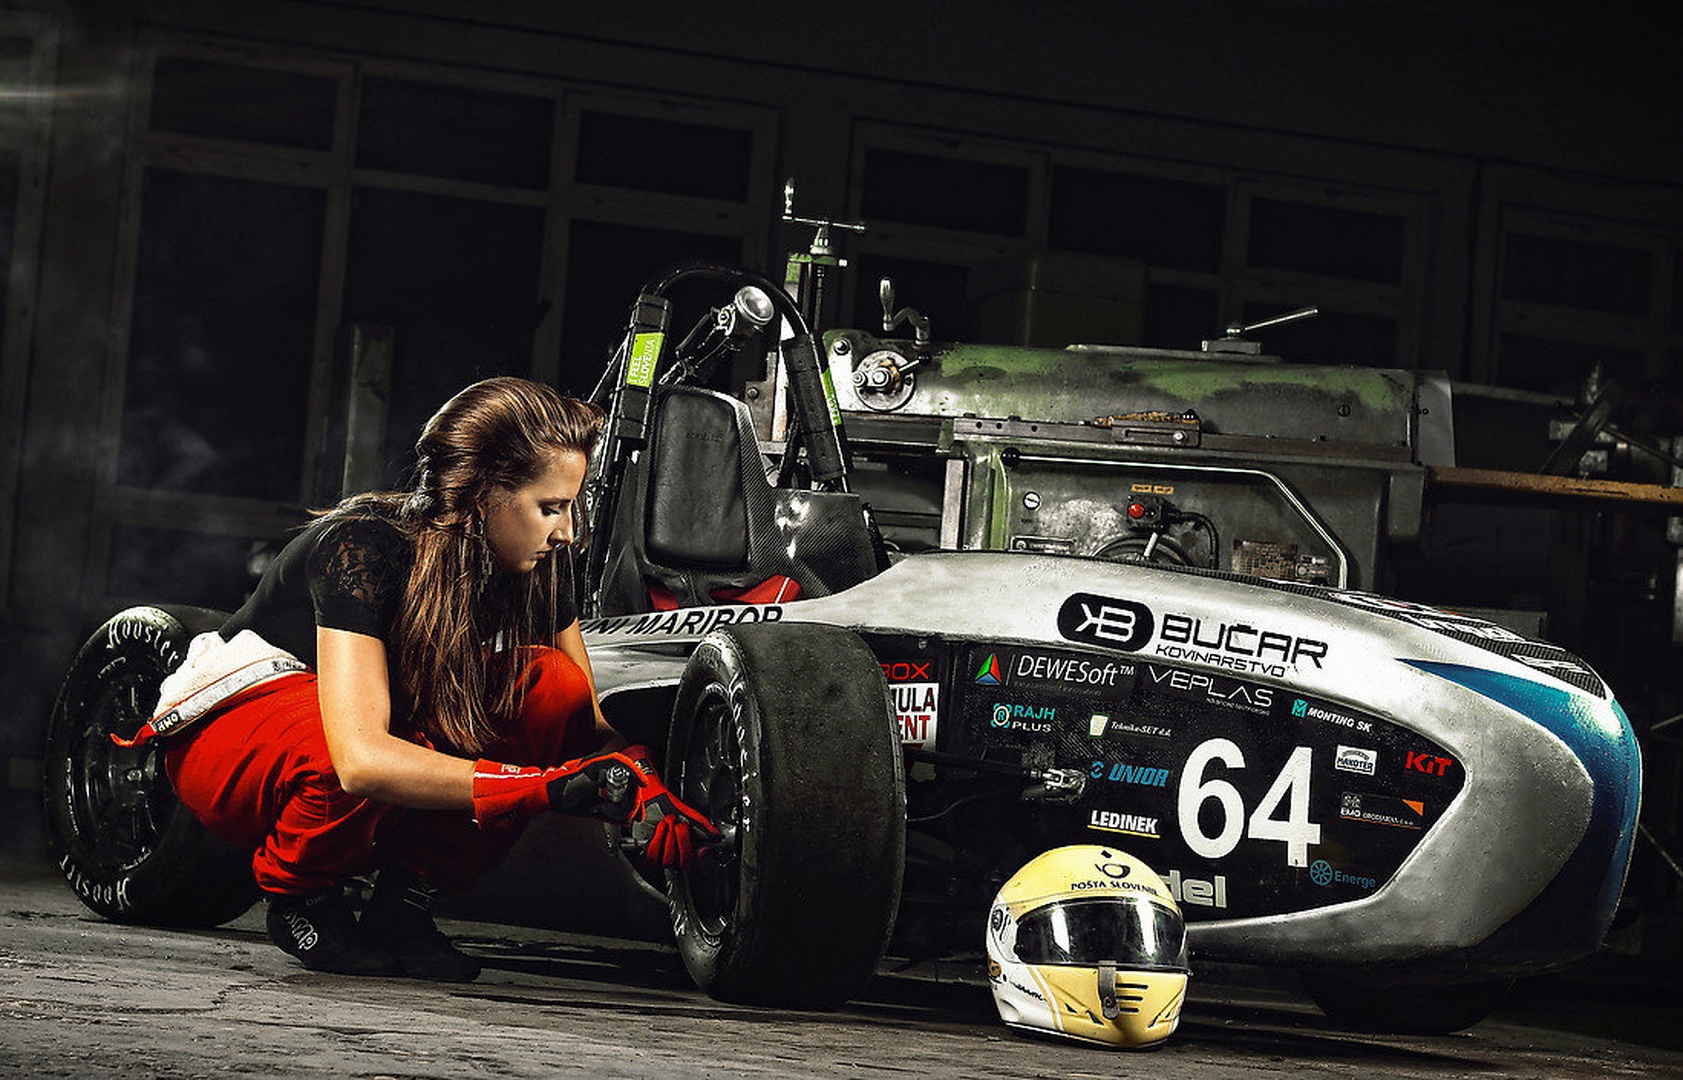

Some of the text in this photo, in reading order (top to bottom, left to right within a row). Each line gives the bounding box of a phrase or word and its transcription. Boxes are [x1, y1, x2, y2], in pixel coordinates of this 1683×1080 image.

[630, 355, 642, 377] FEEL
[640, 339, 655, 385] SLOVENIA
[1160, 614, 1329, 669] BUČAR
[1156, 644, 1286, 678] KOVINARSTVO
[1148, 665, 1274, 707] VEPLAS
[1013, 706, 1056, 720] RAJH
[1308, 707, 1373, 733] MONTING SK
[1011, 720, 1052, 732] PLUS
[1109, 763, 1169, 787] UNIOR
[1178, 738, 1321, 868] 64
[1091, 810, 1158, 834] LEDINEK
[1334, 870, 1376, 889] Energe
